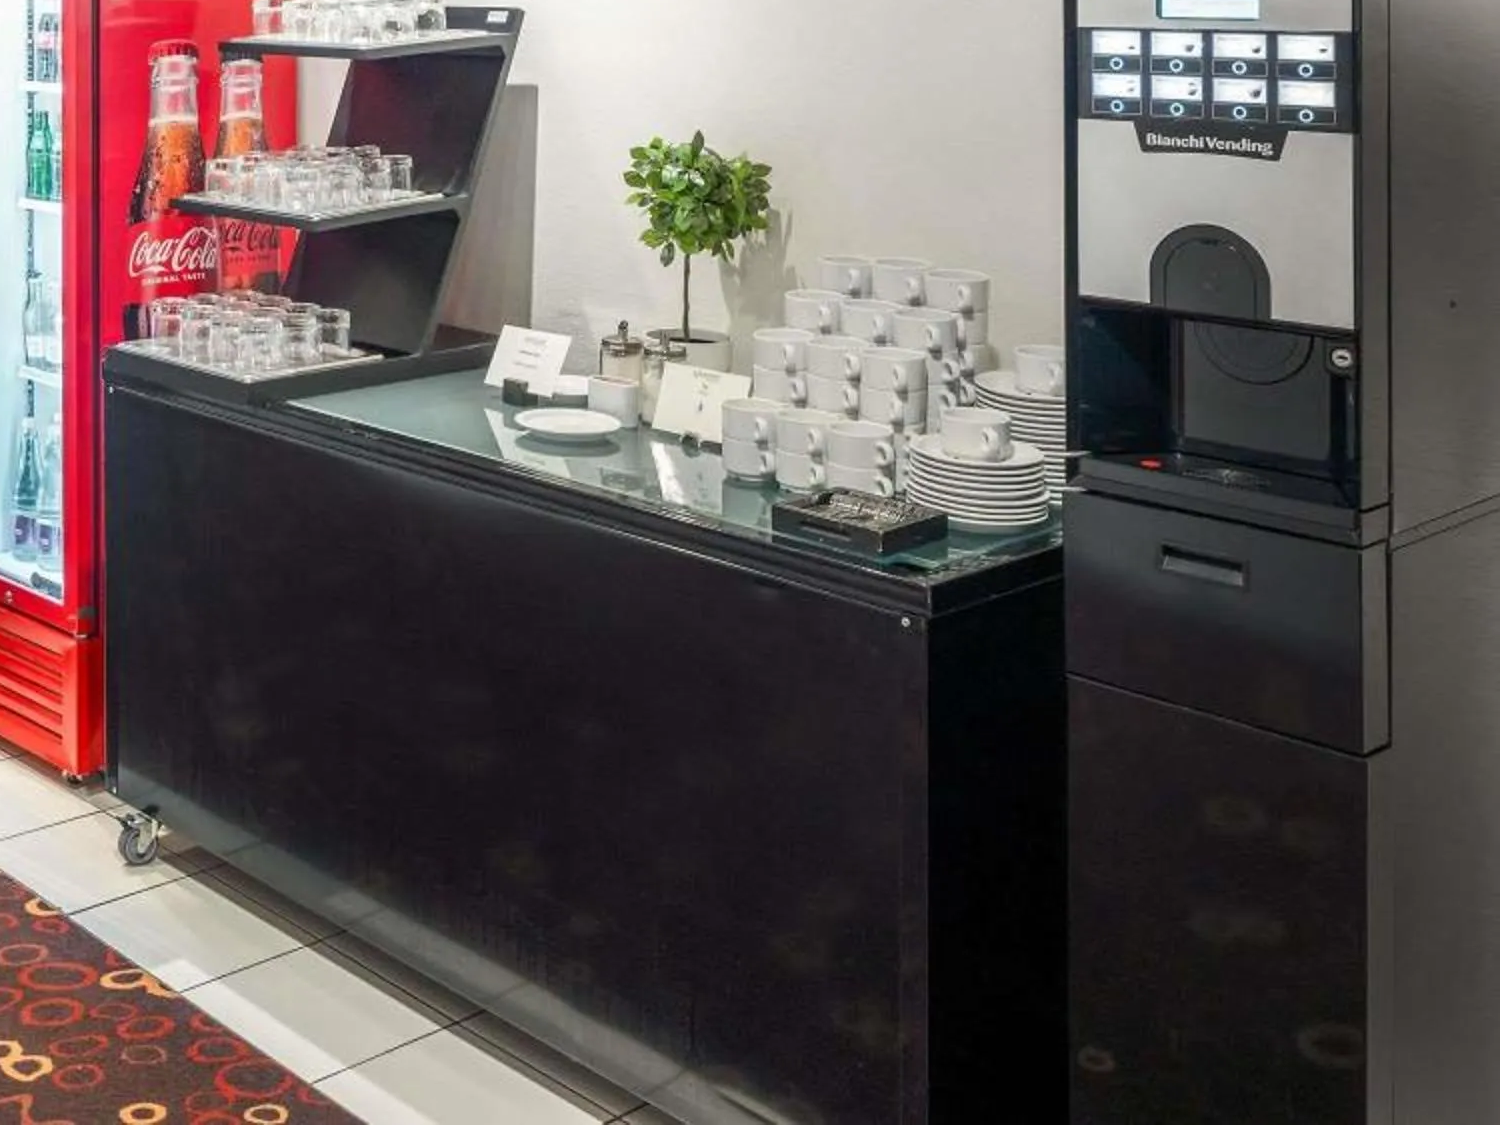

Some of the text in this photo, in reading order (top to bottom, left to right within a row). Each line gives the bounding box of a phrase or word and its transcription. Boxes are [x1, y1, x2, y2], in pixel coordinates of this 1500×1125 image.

[1146, 132, 1274, 156] Bianchi Vending
[129, 226, 218, 278] Coca-Cola
